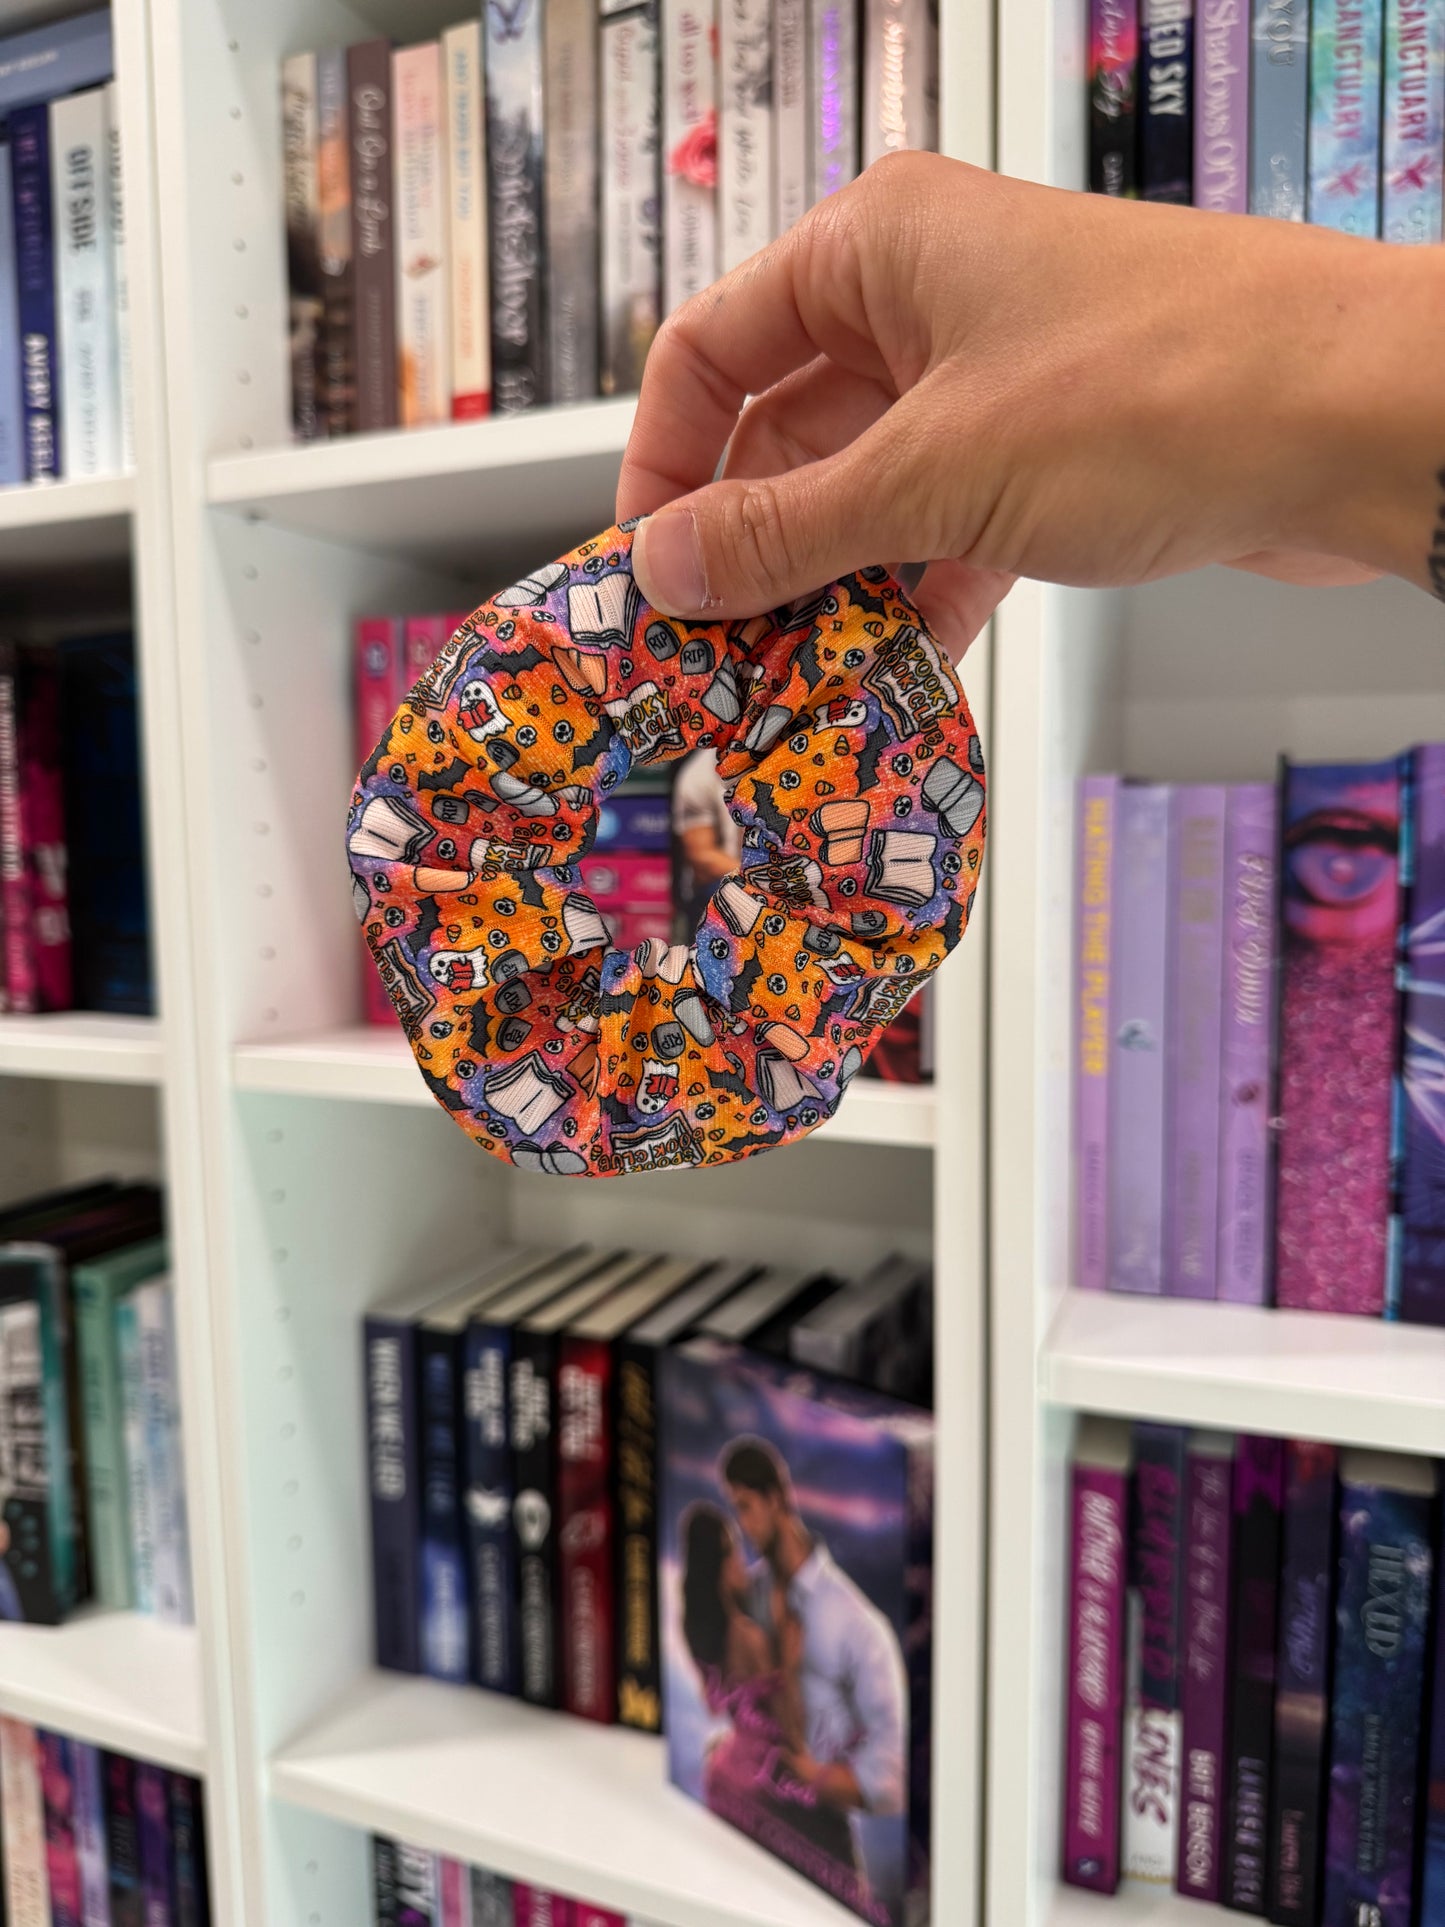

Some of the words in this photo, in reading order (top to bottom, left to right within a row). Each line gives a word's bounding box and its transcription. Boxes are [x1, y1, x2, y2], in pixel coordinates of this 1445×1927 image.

[1149, 0, 1187, 58] RED
[1149, 62, 1187, 115] SKY
[1203, 0, 1240, 137] Shadows
[1332, 0, 1364, 140] SANCTUARY
[1397, 0, 1429, 141] SANCTUARY
[354, 84, 387, 129] Out
[1204, 175, 1239, 213] Yo
[27, 413, 58, 488] KEELA
[411, 662, 446, 718] BOOK
[445, 609, 485, 657] CLUB
[647, 631, 669, 650] RIP
[683, 649, 705, 664] RIP
[873, 637, 918, 691] BOOK
[908, 691, 945, 746] CLUB
[900, 637, 955, 718] SPOOKY
[611, 690, 669, 731] POOKY
[646, 702, 691, 736] CLUB
[441, 799, 458, 821] RIP
[1083, 798, 1111, 905] HATING
[1083, 911, 1110, 963] THE
[392, 986, 423, 1041] BOOK
[505, 1029, 525, 1044] RIP
[855, 998, 891, 1038] CLUB
[1081, 969, 1109, 1077] PLAYER
[661, 1032, 684, 1050] RIP
[597, 1149, 649, 1173] CLUB
[653, 1127, 705, 1159] BOOK
[1188, 1748, 1216, 1800] BRIT
[1186, 1801, 1214, 1888] BENSON
